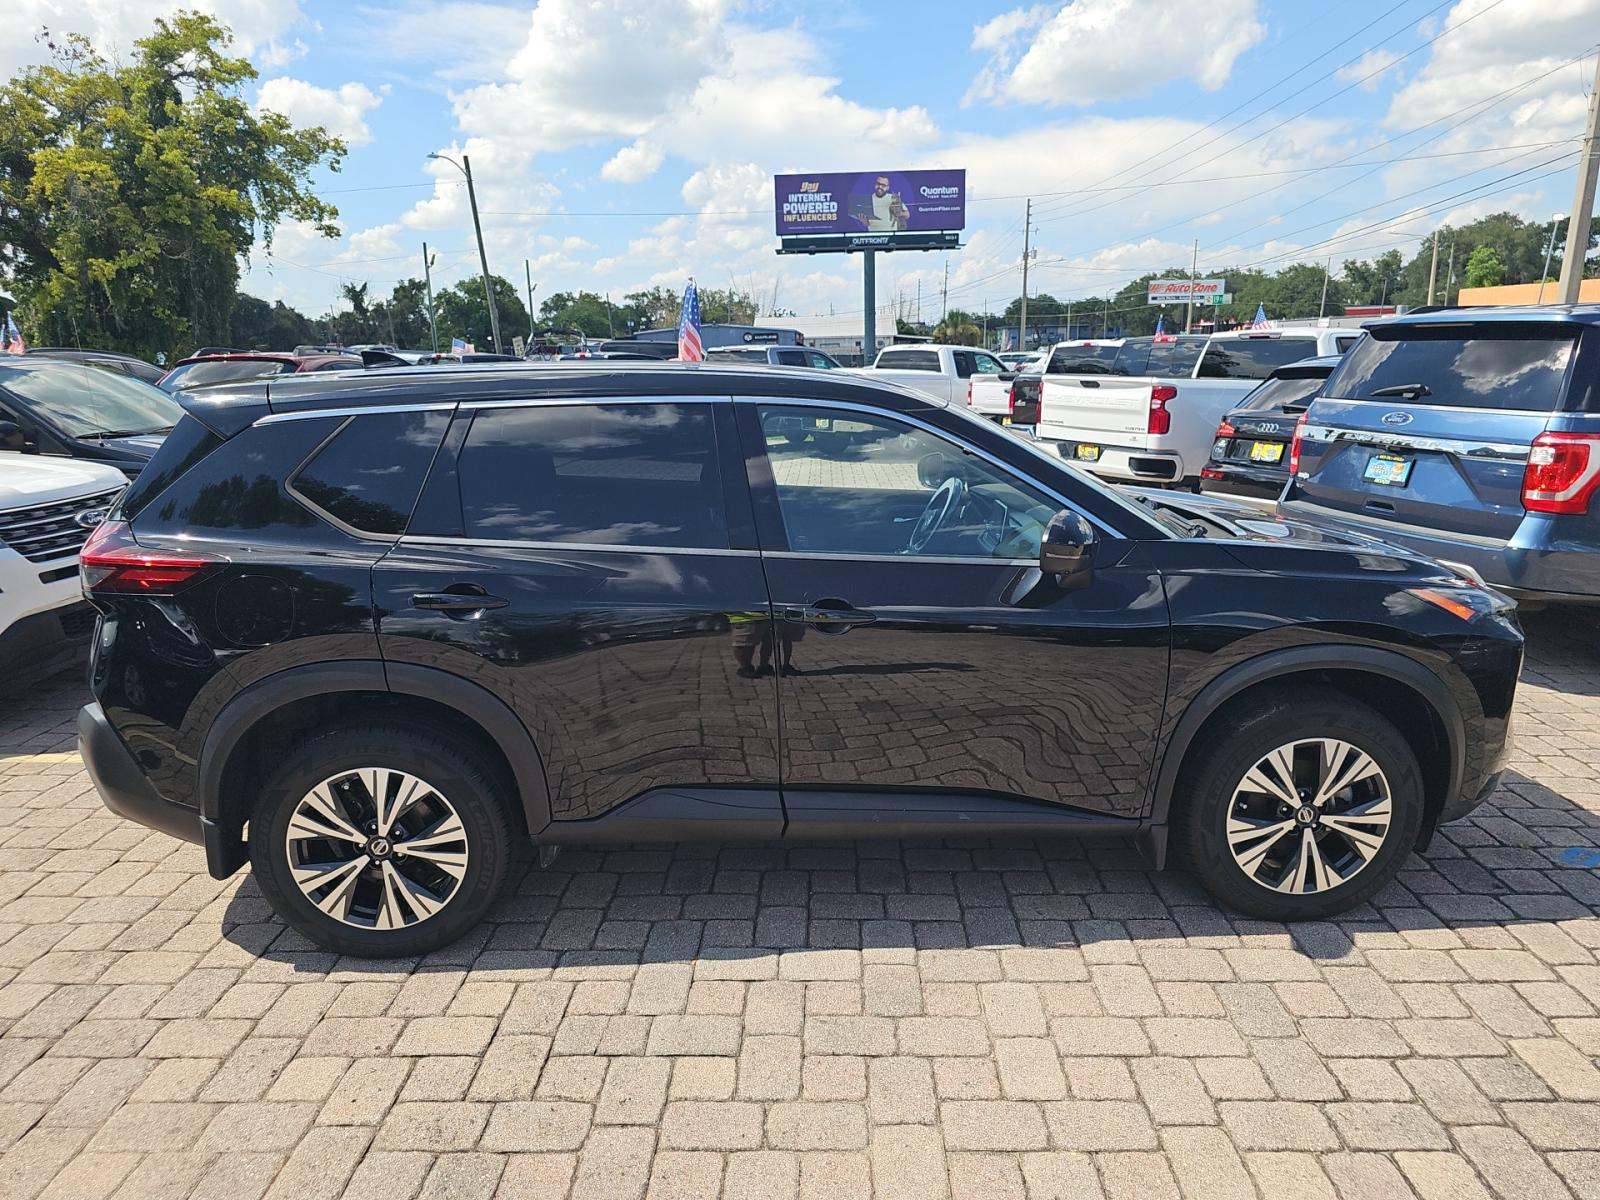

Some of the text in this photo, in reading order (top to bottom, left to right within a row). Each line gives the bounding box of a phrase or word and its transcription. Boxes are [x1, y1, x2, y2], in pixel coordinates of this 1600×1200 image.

[920, 186, 959, 196] Quantum
[788, 193, 832, 202] INTERNET
[783, 202, 838, 214] POWERED
[783, 213, 838, 222] INFLUENCERS
